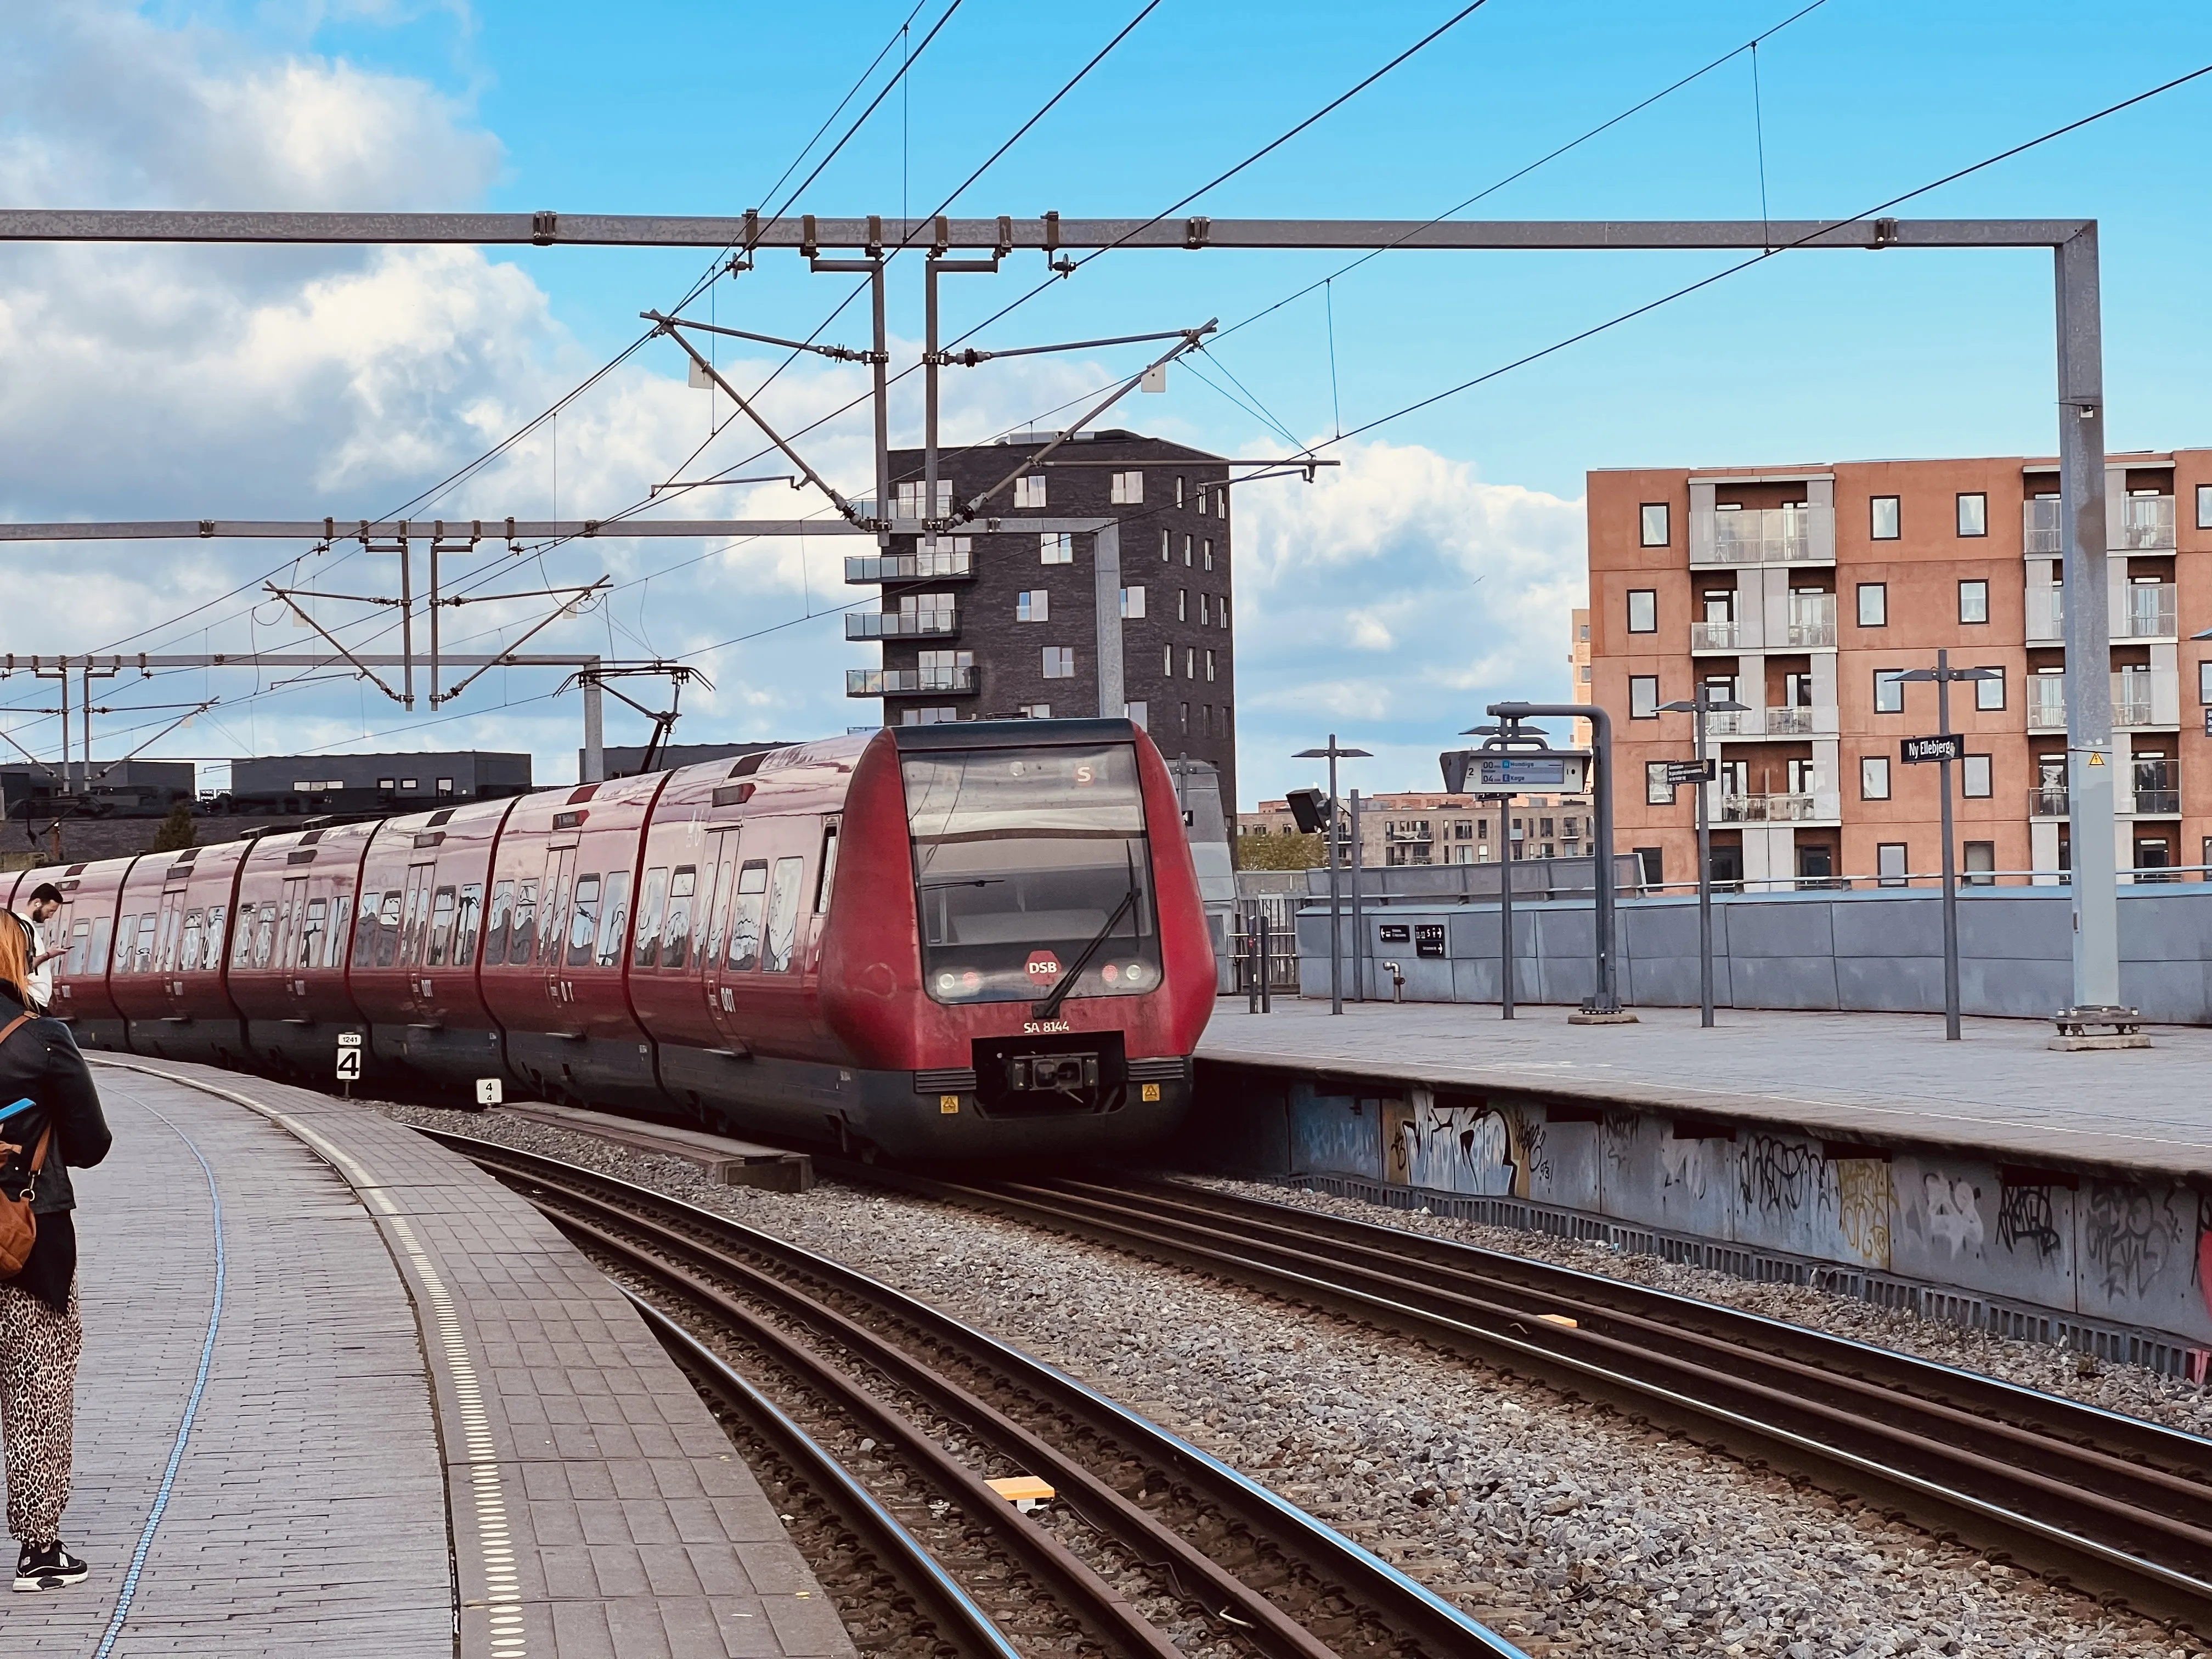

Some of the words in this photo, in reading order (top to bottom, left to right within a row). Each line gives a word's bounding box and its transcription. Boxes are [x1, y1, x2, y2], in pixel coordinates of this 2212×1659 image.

[1909, 742, 1919, 759] Ny
[1920, 740, 1950, 757] Ellebjerg
[1077, 766, 1091, 782] S
[1468, 768, 1474, 776] 2
[1029, 962, 1057, 974] DSB
[1023, 1022, 1040, 1034] SA
[1043, 1021, 1069, 1032] 8144
[338, 1052, 359, 1076] 4
[486, 1082, 493, 1091] 4
